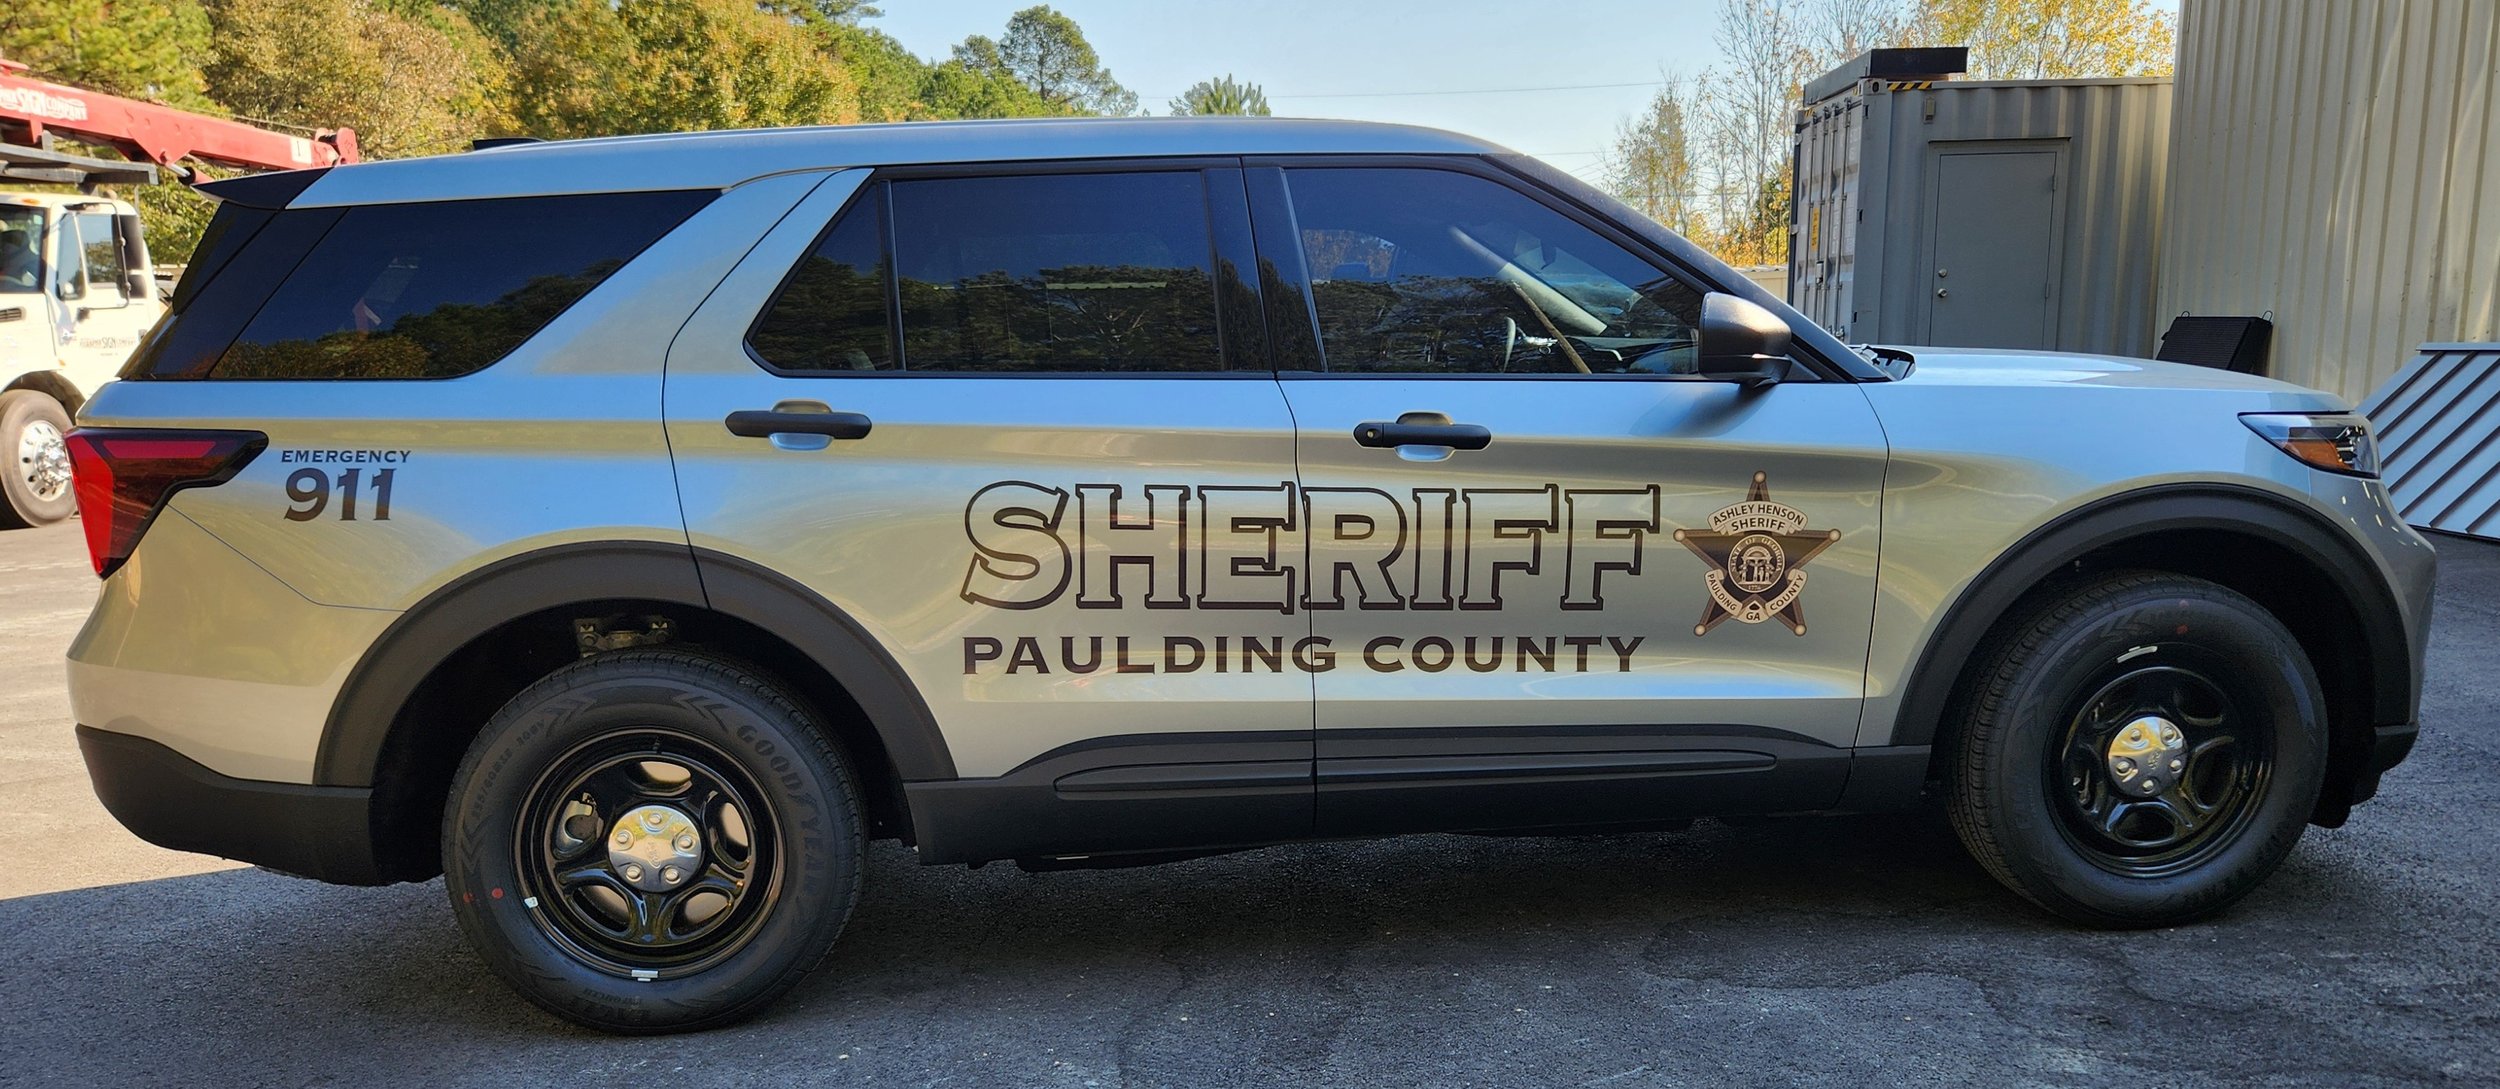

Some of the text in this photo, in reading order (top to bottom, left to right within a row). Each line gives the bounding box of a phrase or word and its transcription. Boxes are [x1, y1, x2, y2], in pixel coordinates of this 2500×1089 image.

[281, 450, 411, 463] EMERGENCY
[284, 468, 397, 522] 911
[1713, 504, 1804, 526] ASHLEY HENSON
[1731, 517, 1786, 532] SHERIFF
[960, 480, 1660, 615] SHERIFF
[1761, 537, 1783, 572] GEORGIA
[1707, 573, 1804, 611] PAULDING COUNTY
[1746, 611, 1761, 621] GA
[962, 635, 1645, 675] PAULDING COUNTY
